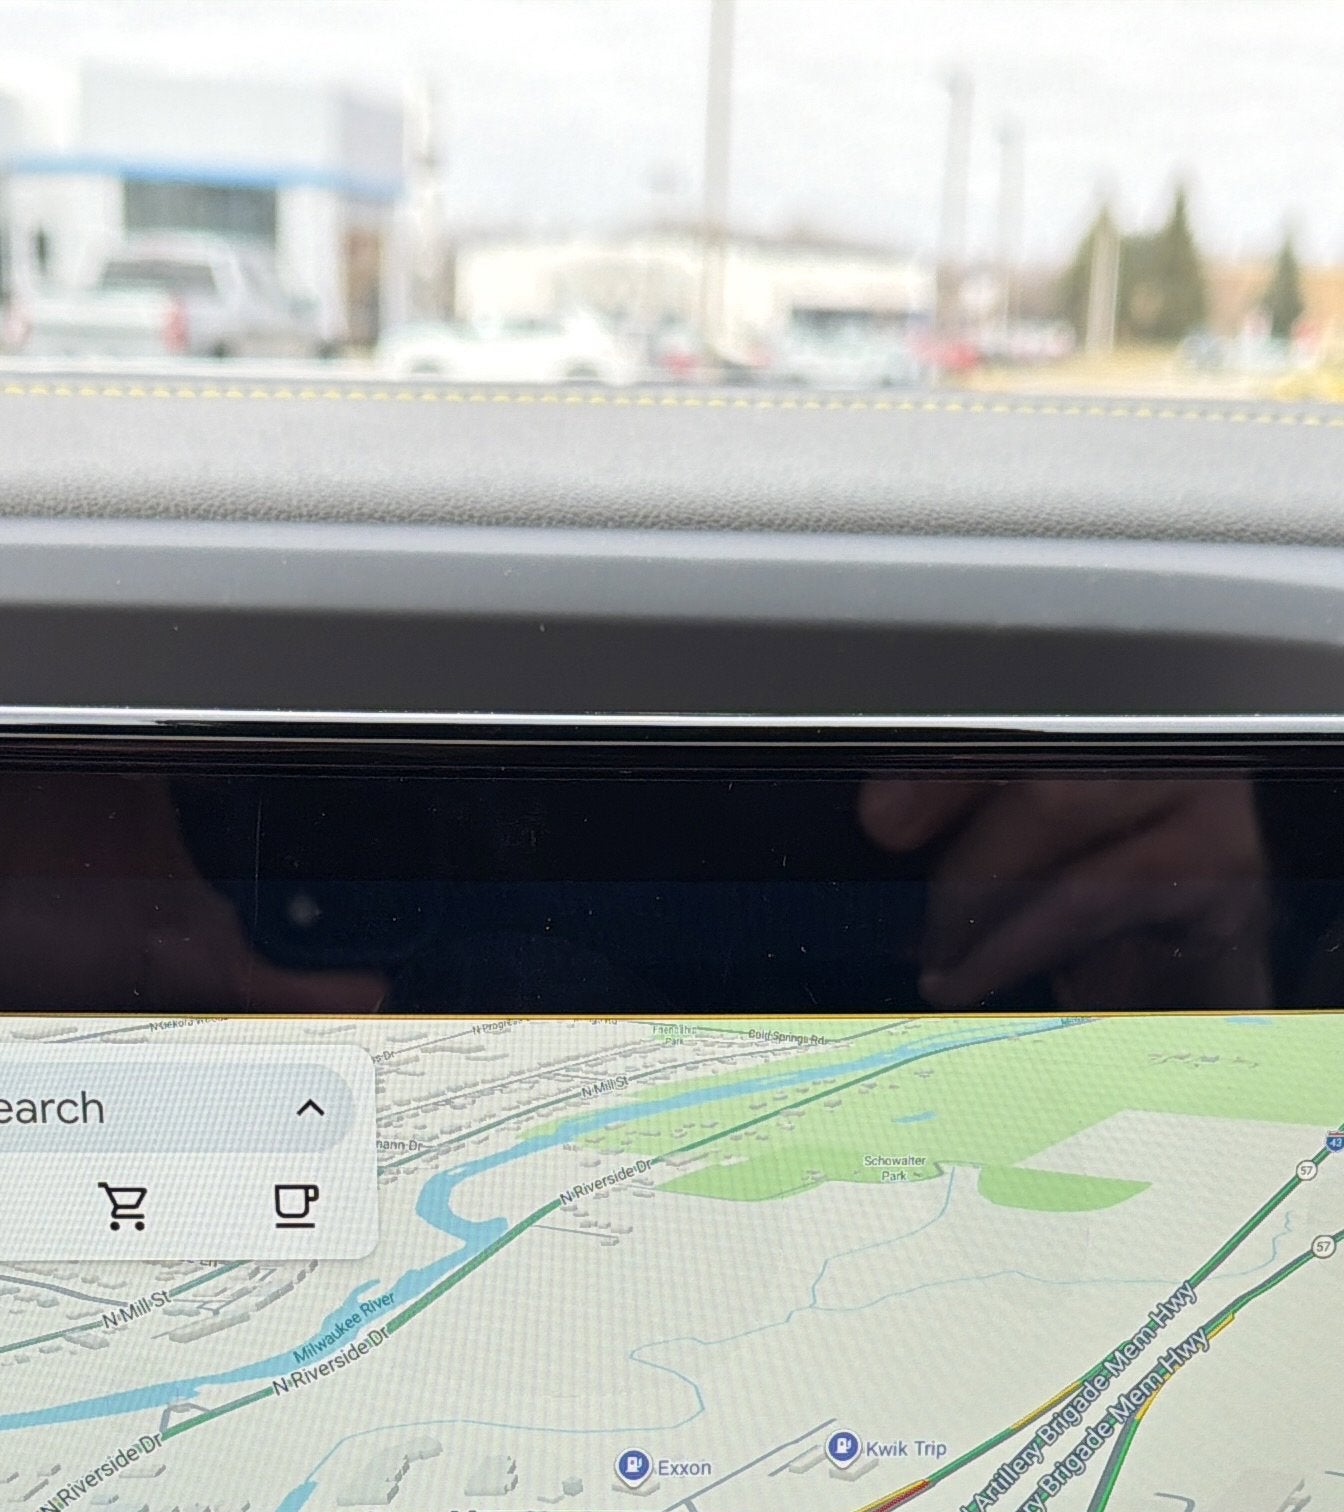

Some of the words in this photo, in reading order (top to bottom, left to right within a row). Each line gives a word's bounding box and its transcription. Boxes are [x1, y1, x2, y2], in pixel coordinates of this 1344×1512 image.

[581, 1087, 592, 1098] N
[593, 1078, 615, 1094] Mill
[615, 1075, 629, 1088] St
[408, 1139, 424, 1151] Dr
[864, 1154, 927, 1167] Schowalter
[559, 1190, 574, 1206] N
[573, 1166, 636, 1199] Riverside
[635, 1158, 652, 1174] Dr
[881, 1170, 908, 1182] Park
[1315, 1240, 1333, 1253] 57
[102, 1312, 119, 1329] N
[119, 1297, 153, 1324] Mill
[151, 1289, 173, 1310] St
[293, 1312, 362, 1364] Milwaukee
[359, 1290, 397, 1323] River
[272, 1376, 291, 1397] N
[291, 1341, 370, 1389] Riverside
[367, 1324, 391, 1348] Dr
[1036, 1372, 1110, 1447] Brigade
[1103, 1323, 1158, 1379] Mem
[1149, 1279, 1198, 1329] Hwy
[1037, 1425, 1115, 1498] Brigade
[1107, 1366, 1166, 1426] Mem
[1158, 1326, 1211, 1376] Hwy
[866, 1440, 908, 1457] Kwik
[914, 1440, 948, 1460] Trip
[56, 1448, 141, 1508] Riverside
[139, 1432, 164, 1455] Dr
[658, 1459, 713, 1477] Exxon
